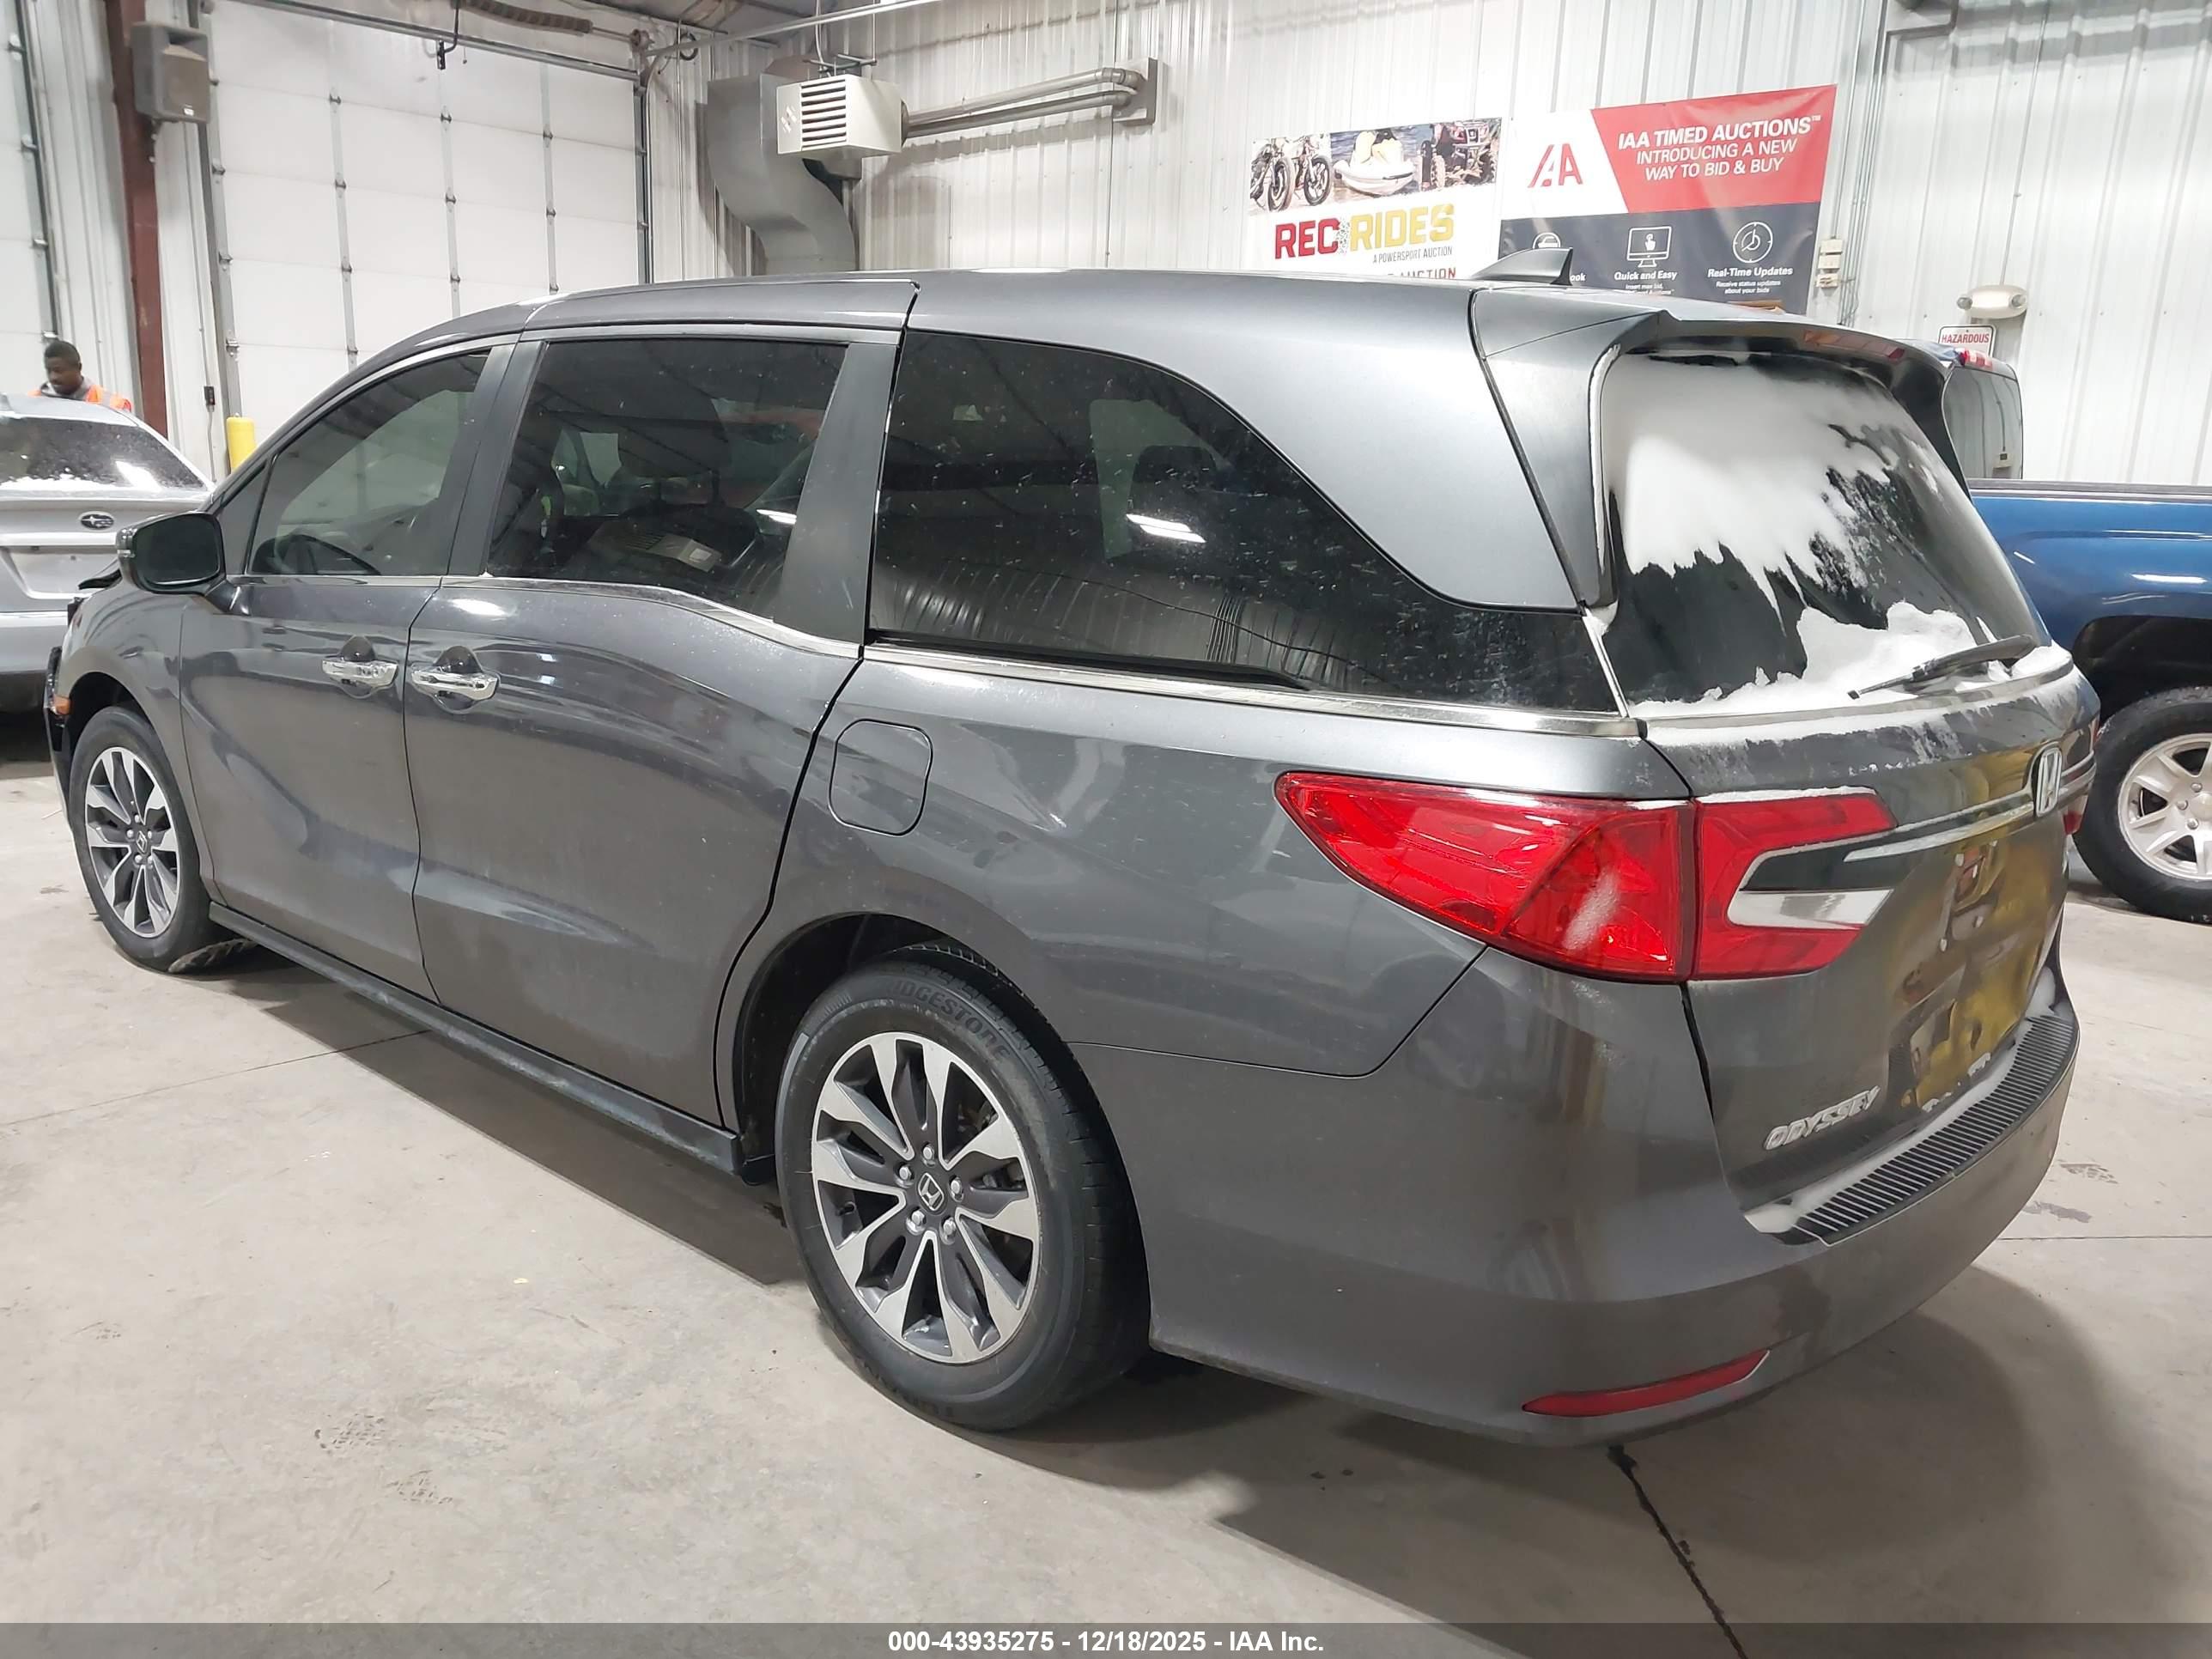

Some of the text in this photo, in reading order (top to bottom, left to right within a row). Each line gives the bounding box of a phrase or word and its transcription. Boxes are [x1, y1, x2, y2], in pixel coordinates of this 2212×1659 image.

[1618, 131, 1650, 150] IAA
[1654, 127, 1707, 146] TIMED
[1637, 138, 1797, 165] INTRODUCING A NEW
[1645, 157, 1784, 181] WAY TO BID & BUY
[1275, 204, 1454, 260] REC RIDES
[1373, 246, 1453, 264] A POWERSPORT AUCTION
[1614, 270, 1677, 281] Quick and Easy
[1707, 266, 1793, 278] Real-Time Updates
[1942, 333, 1990, 343] HAZARDOUS
